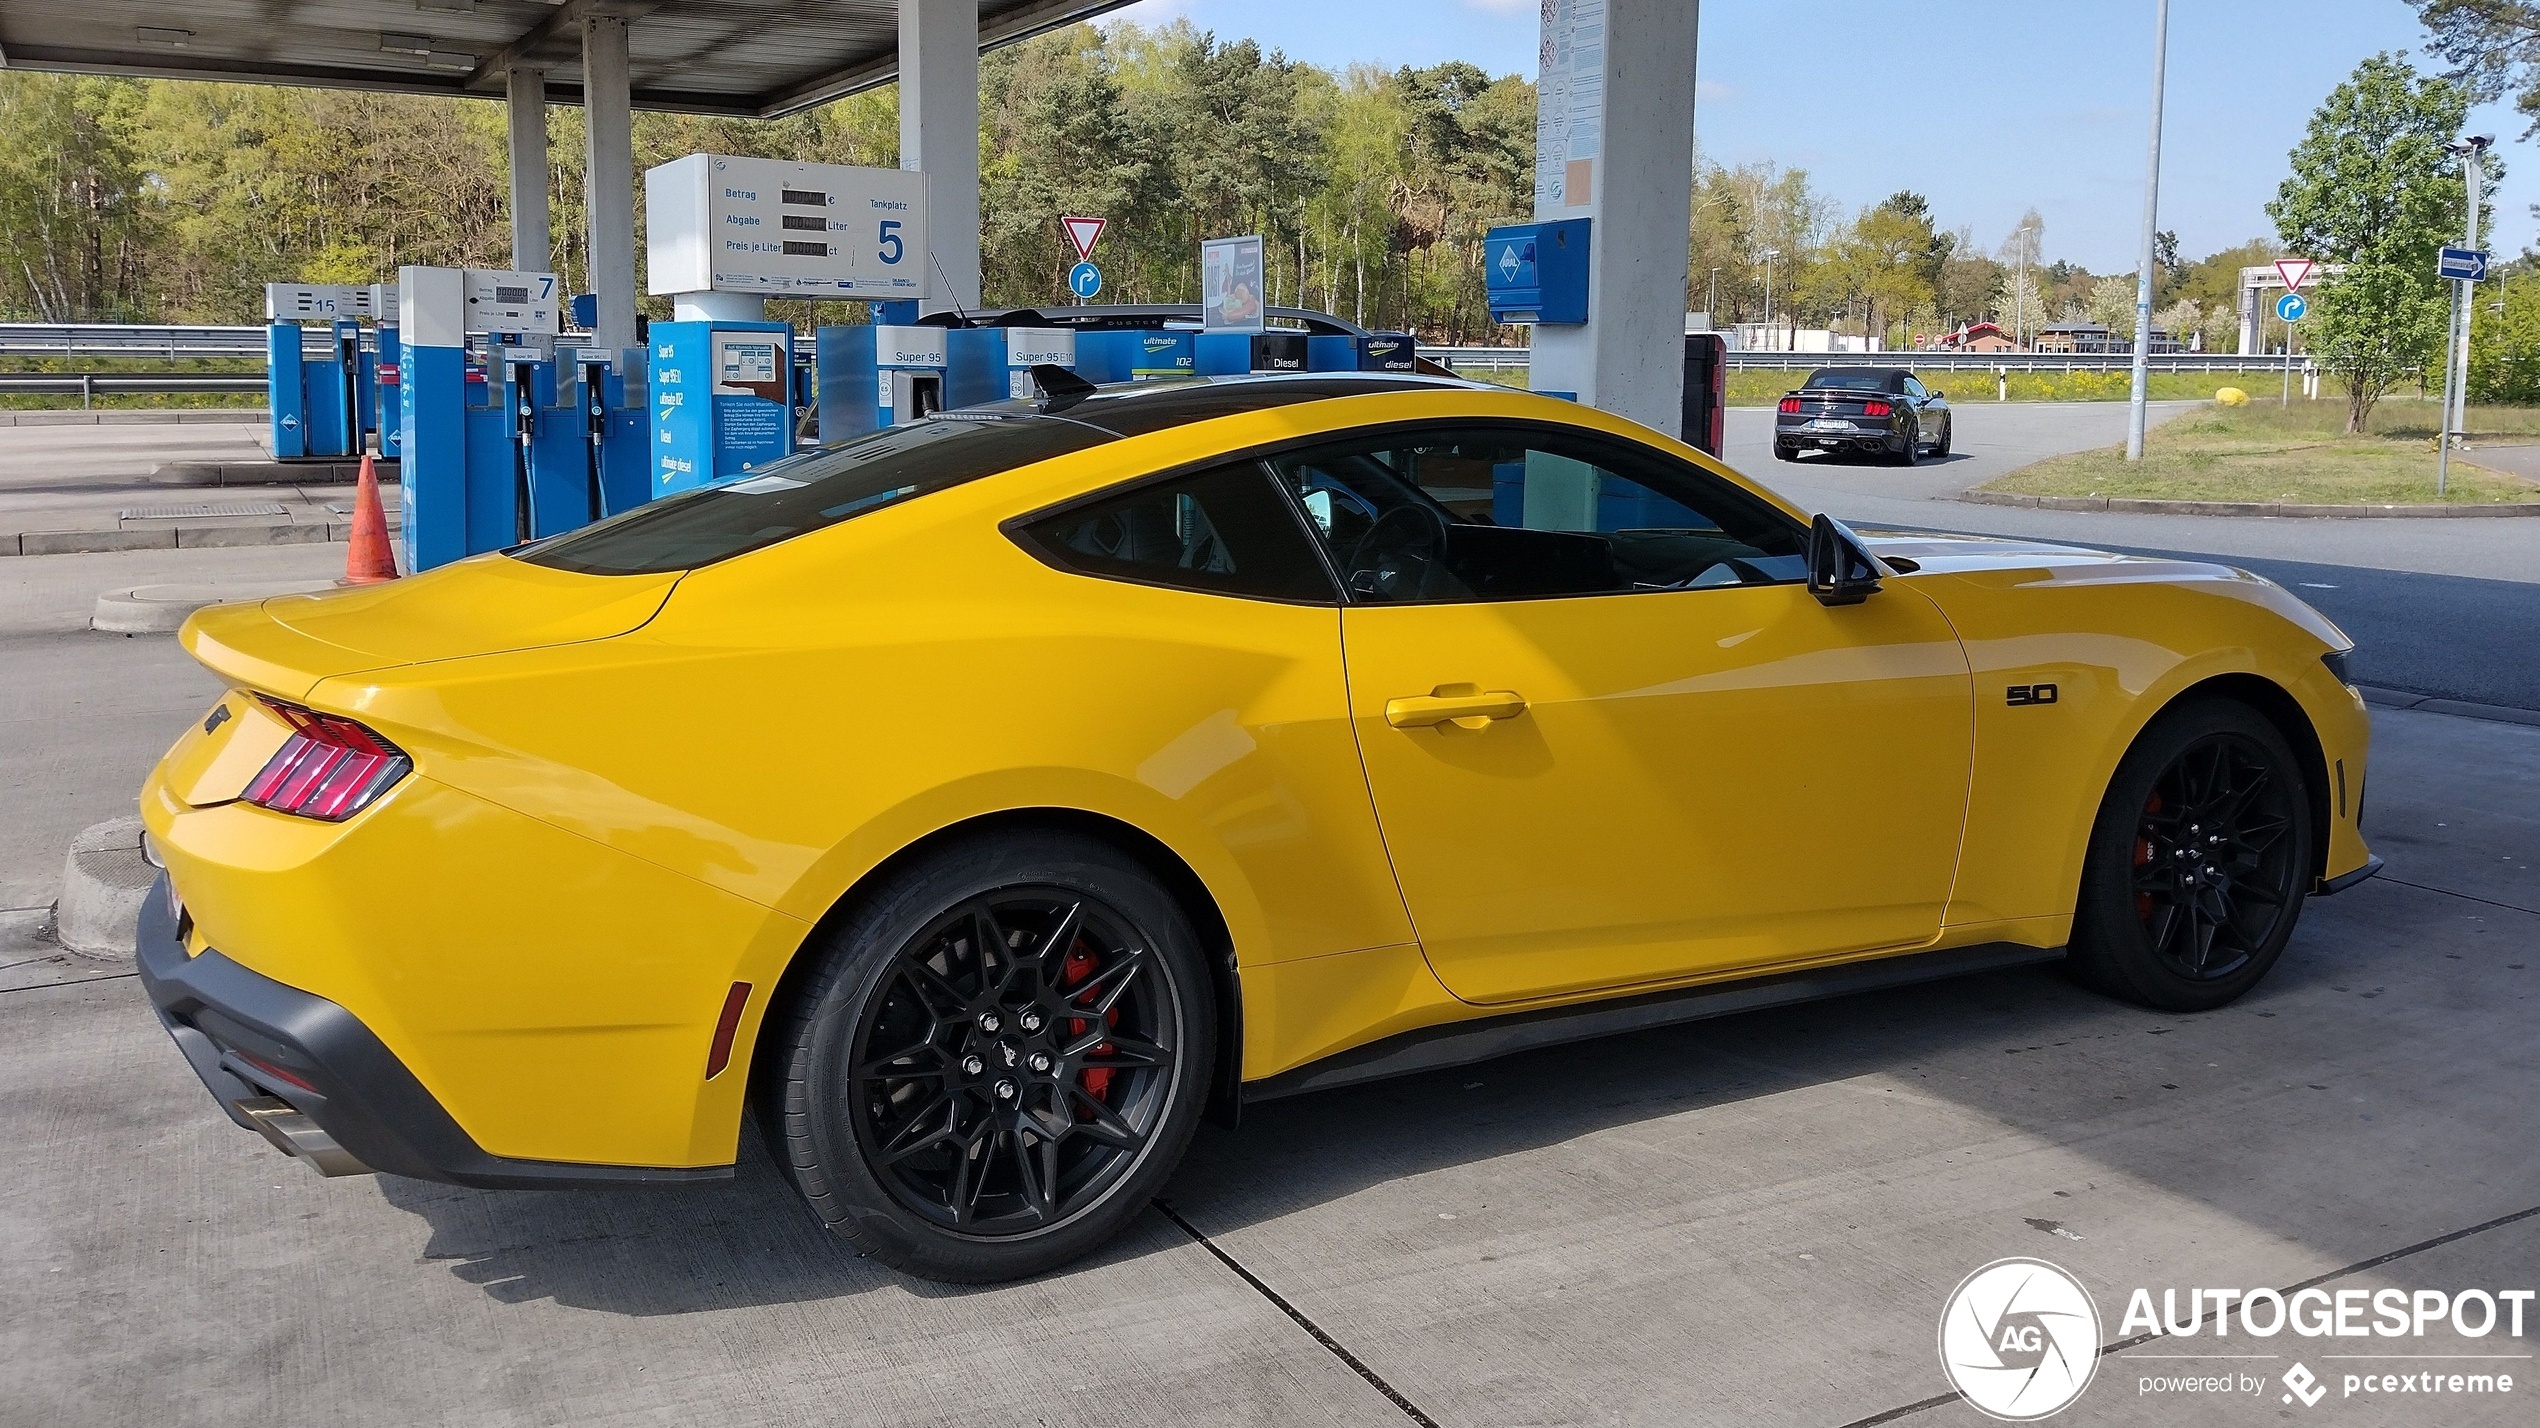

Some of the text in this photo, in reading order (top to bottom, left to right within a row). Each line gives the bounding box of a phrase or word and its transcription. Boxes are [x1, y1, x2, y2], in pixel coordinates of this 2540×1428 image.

[726, 188, 756, 201] Betrag
[827, 196, 835, 205] €
[870, 199, 907, 211] Tankplatz
[726, 215, 760, 226] Abgabe
[828, 221, 848, 231] Liter
[726, 240, 782, 252] Preis je Liter
[878, 220, 904, 265] 5
[828, 247, 837, 255] ct
[538, 277, 554, 300] 7
[315, 299, 335, 312] 15
[1143, 337, 1177, 345] ultimate
[1368, 341, 1399, 349] ultimate
[659, 344, 668, 360] Super
[896, 351, 941, 364] Super 95
[1015, 351, 1073, 364] Super 95 E10
[1176, 357, 1192, 366] 102
[1274, 358, 1299, 368] Diesel
[1385, 360, 1412, 369] diesel
